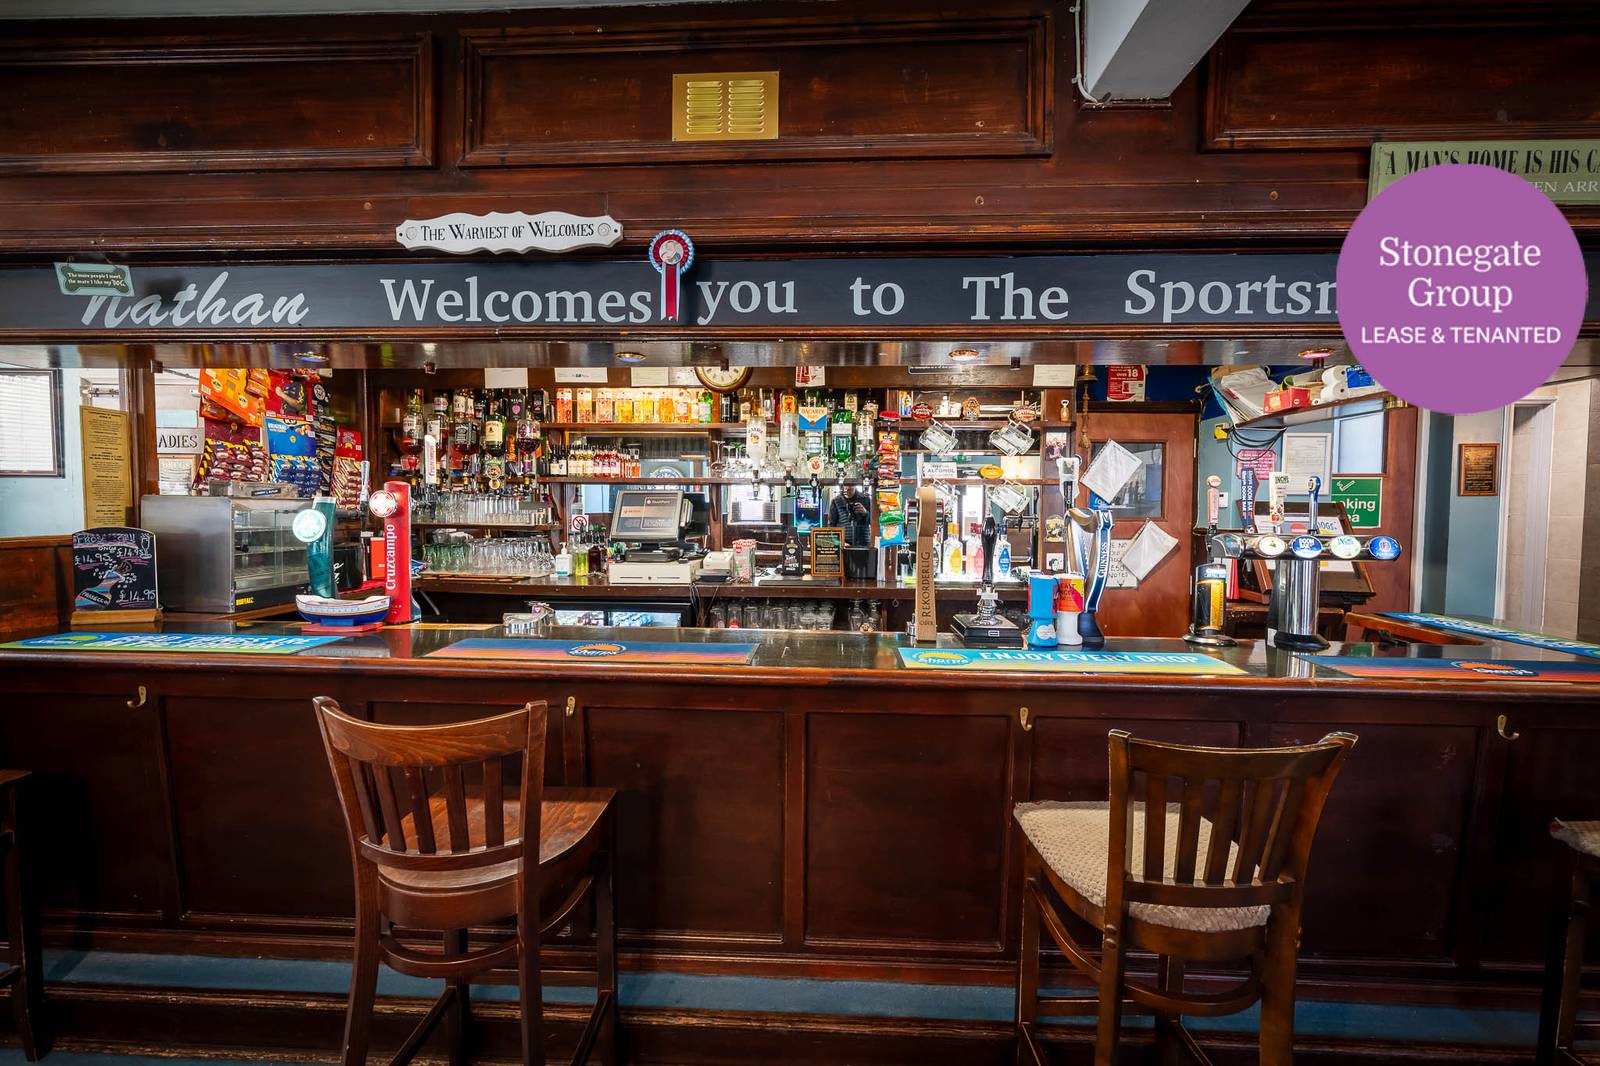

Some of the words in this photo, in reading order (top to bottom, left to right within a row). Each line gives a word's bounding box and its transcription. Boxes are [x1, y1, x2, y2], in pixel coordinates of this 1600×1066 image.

[1385, 151, 1396, 175] A
[1524, 150, 1544, 174] IS
[1548, 149, 1580, 174] HIS
[1586, 148, 1600, 173] C
[1528, 181, 1557, 192] EN
[420, 225, 445, 241] THE
[449, 223, 508, 240] WARMEST
[512, 225, 525, 238] OF
[528, 221, 594, 237] WELCOMES
[379, 276, 652, 323] Welcomes
[696, 279, 798, 326] you
[849, 276, 905, 316] to
[962, 272, 1069, 321] The
[1128, 369, 1138, 378] 18
[158, 434, 198, 449] ADIES
[386, 524, 398, 590] Cruzcampo
[920, 552, 932, 618] REKORDERLIG
[979, 652, 1054, 661] ENJOY
[1057, 653, 1133, 662] EVERY
[1135, 655, 1199, 664] DROP
